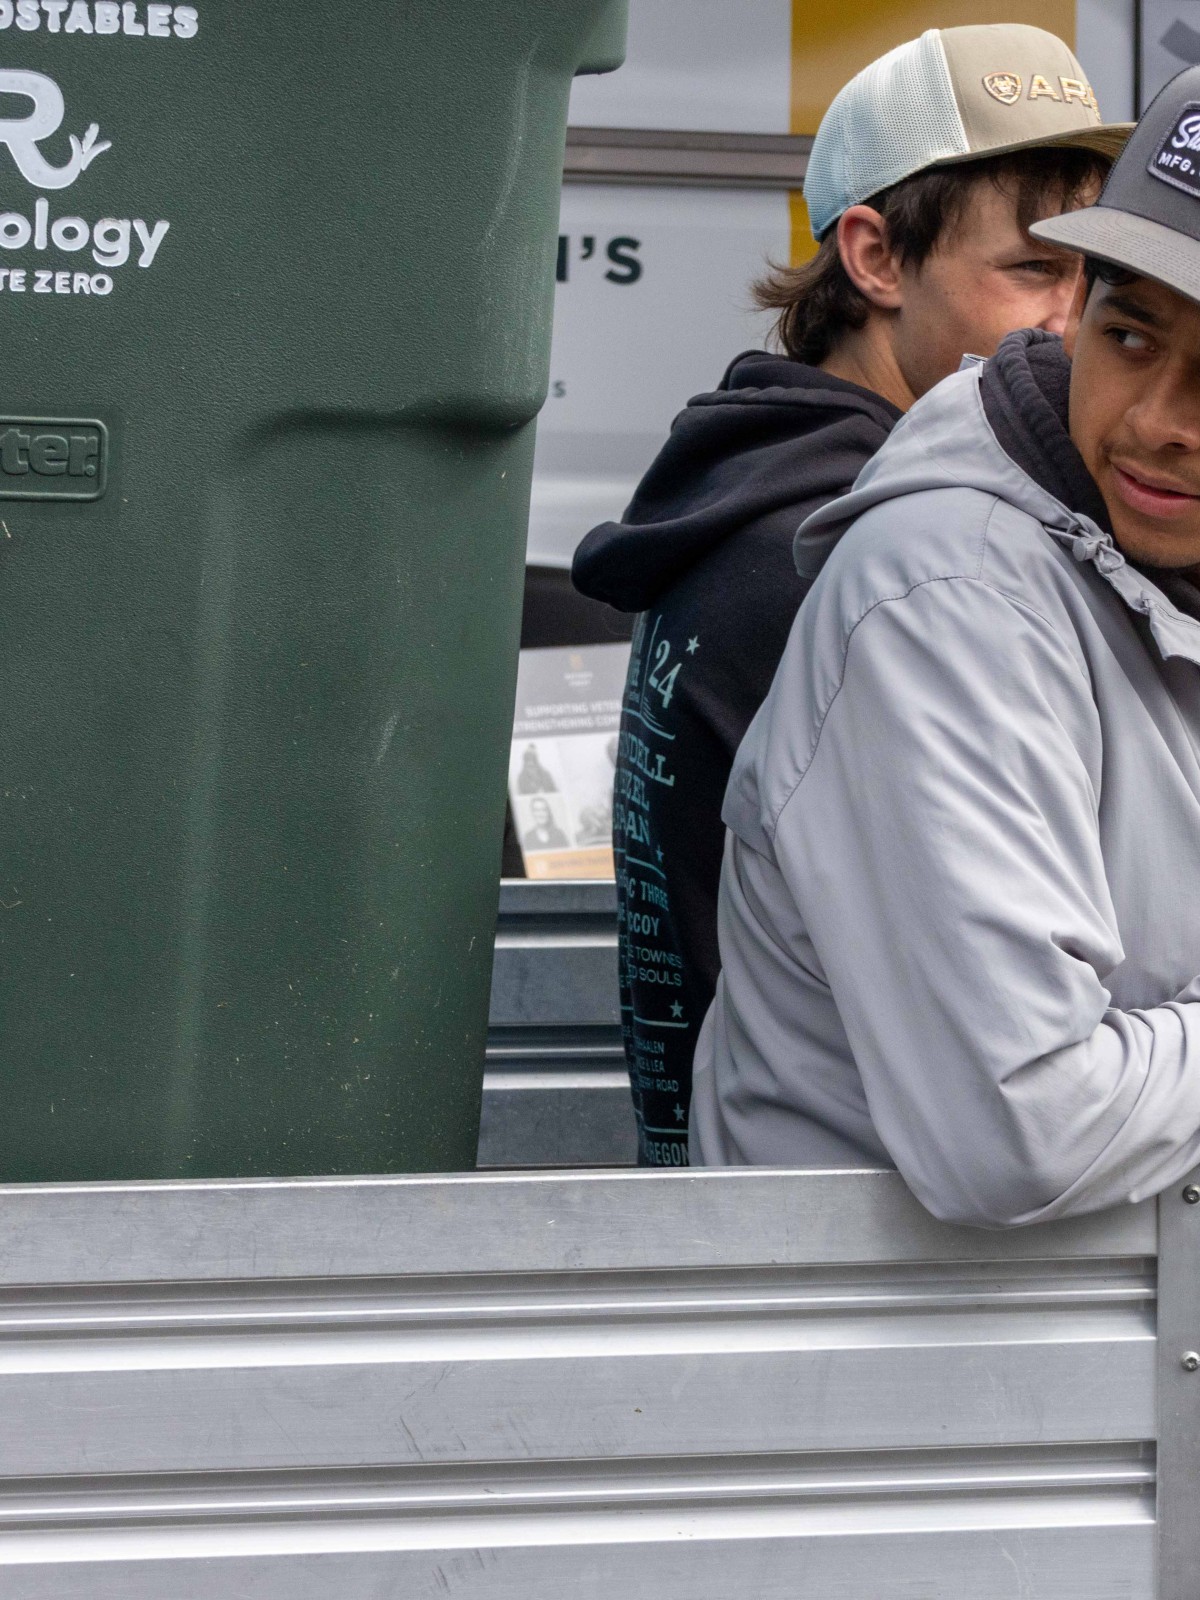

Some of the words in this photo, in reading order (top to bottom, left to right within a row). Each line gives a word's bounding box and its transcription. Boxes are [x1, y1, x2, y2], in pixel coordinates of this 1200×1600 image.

[0, 197, 170, 268] ology
[33, 270, 114, 296] ZERO
[556, 235, 643, 285] 'S
[648, 639, 683, 709] 24
[639, 967, 682, 988] SOULS
